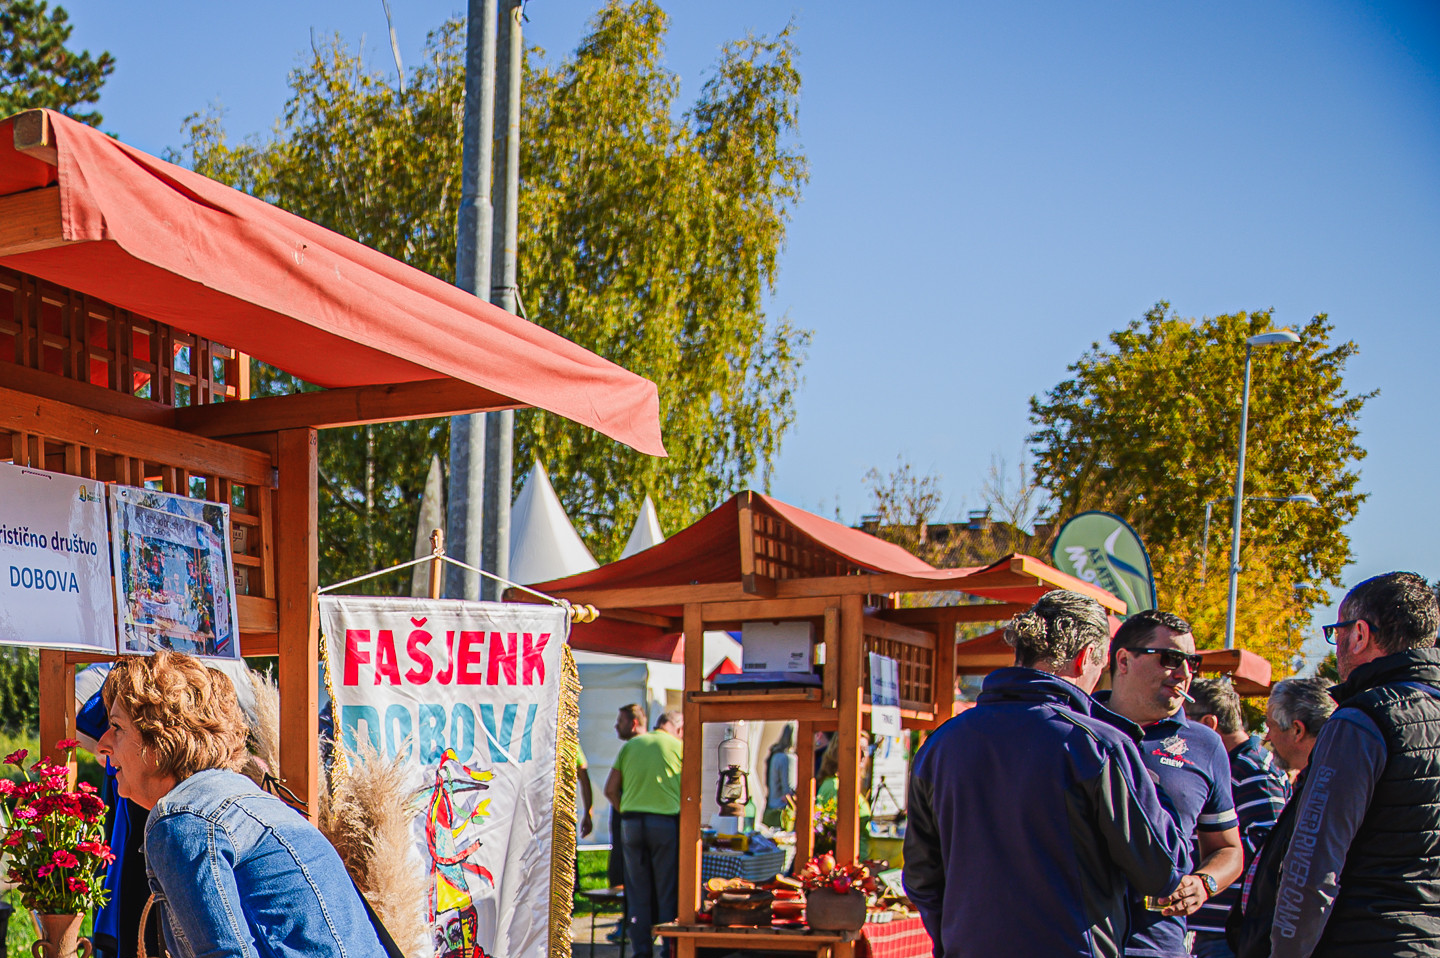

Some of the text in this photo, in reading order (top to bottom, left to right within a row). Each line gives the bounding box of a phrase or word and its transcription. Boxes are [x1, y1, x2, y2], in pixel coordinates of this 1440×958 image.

[51, 531, 98, 556] društvo
[9, 565, 80, 594] DOBOVA
[342, 616, 552, 687] FAŠJENK
[1159, 756, 1185, 769] CREW
[1288, 831, 1317, 888] RIVER
[1272, 887, 1304, 940] CAMP
